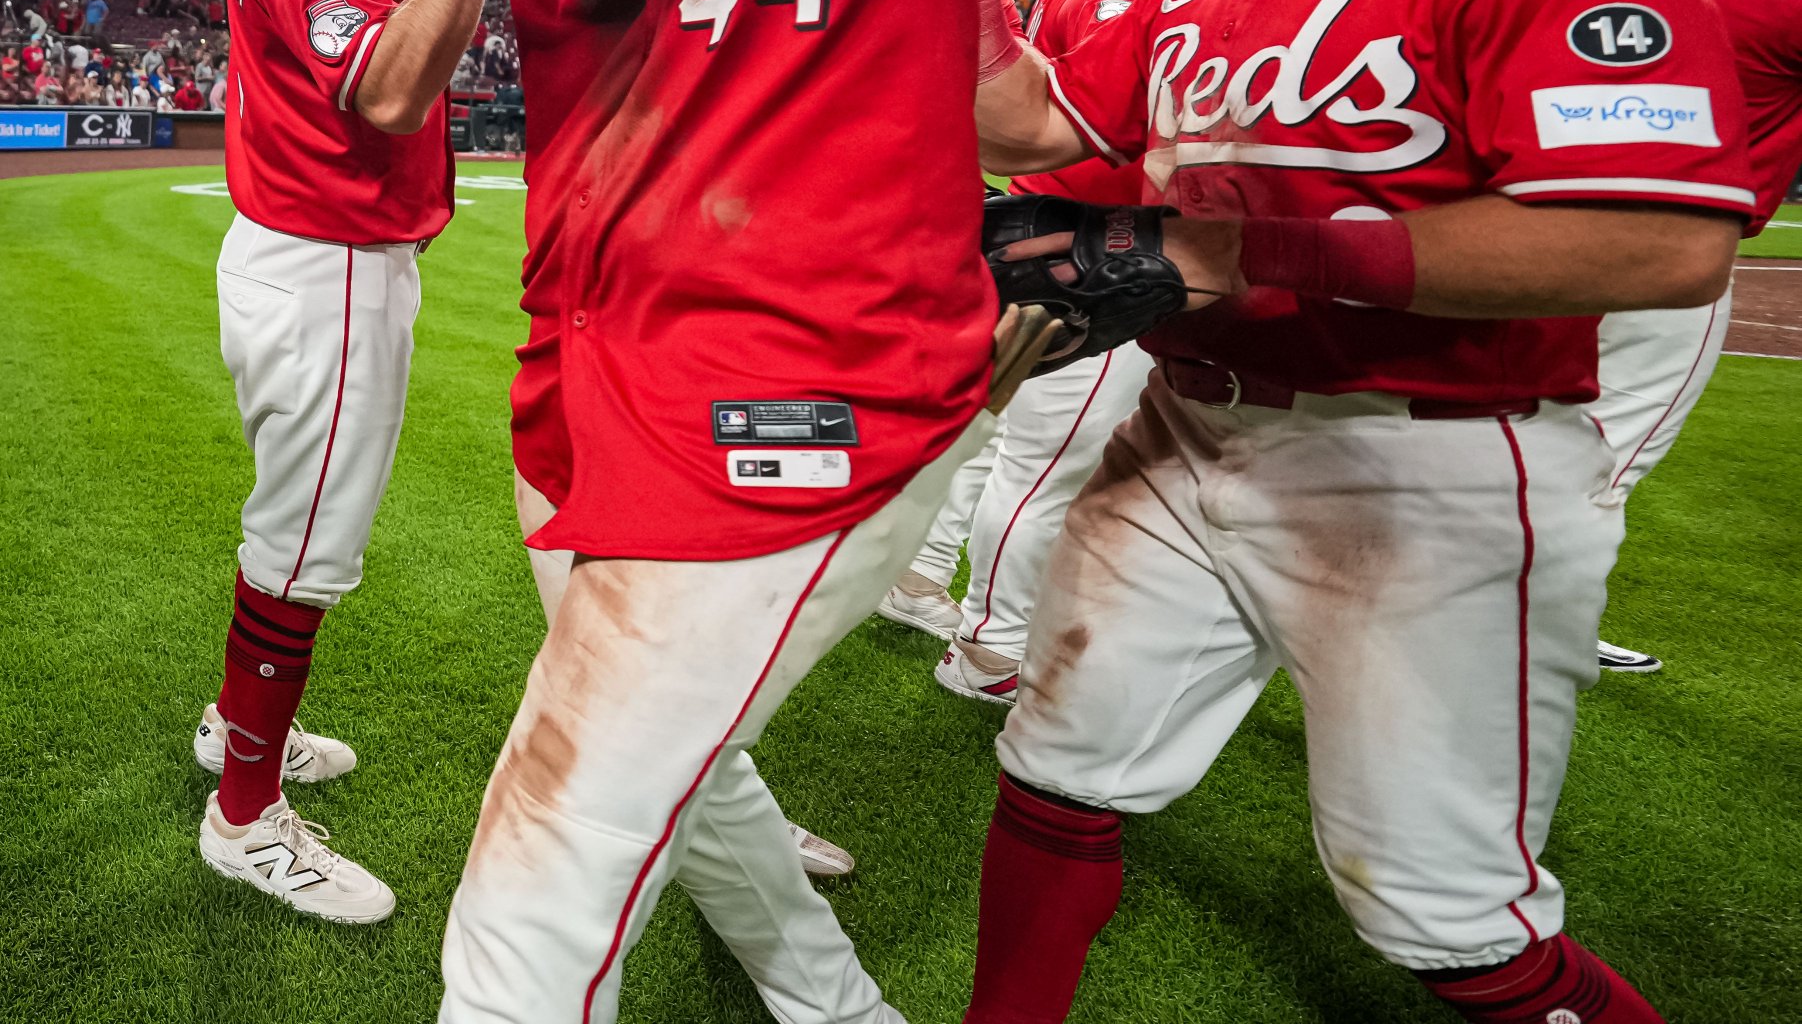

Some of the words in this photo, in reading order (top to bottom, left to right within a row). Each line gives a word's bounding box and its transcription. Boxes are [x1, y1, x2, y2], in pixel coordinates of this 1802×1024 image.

[1588, 14, 1653, 55] 14
[81, 113, 105, 137] C
[1602, 95, 1698, 131] Kroger
